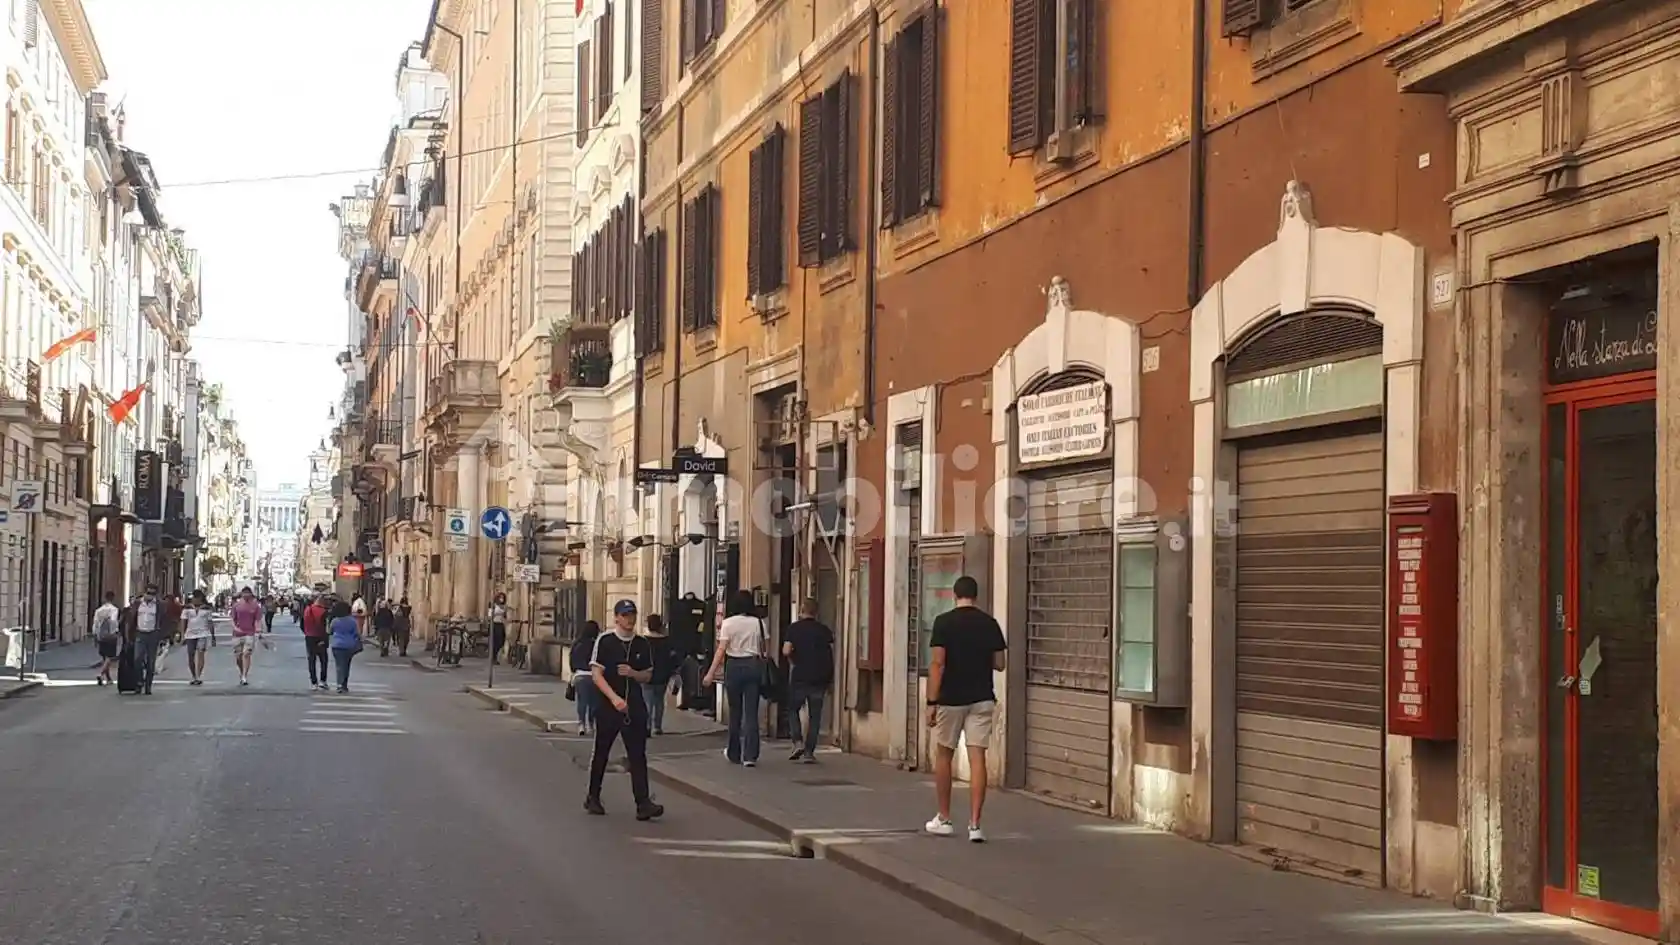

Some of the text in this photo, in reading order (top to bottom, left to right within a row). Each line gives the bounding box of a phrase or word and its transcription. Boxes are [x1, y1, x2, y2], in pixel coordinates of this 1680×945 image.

[1435, 279, 1450, 299] 527
[1554, 318, 1588, 369] Nella
[1632, 321, 1643, 356] di
[1022, 397, 1039, 412] SOLO
[139, 453, 151, 489] ROMA
[684, 460, 716, 471] David
